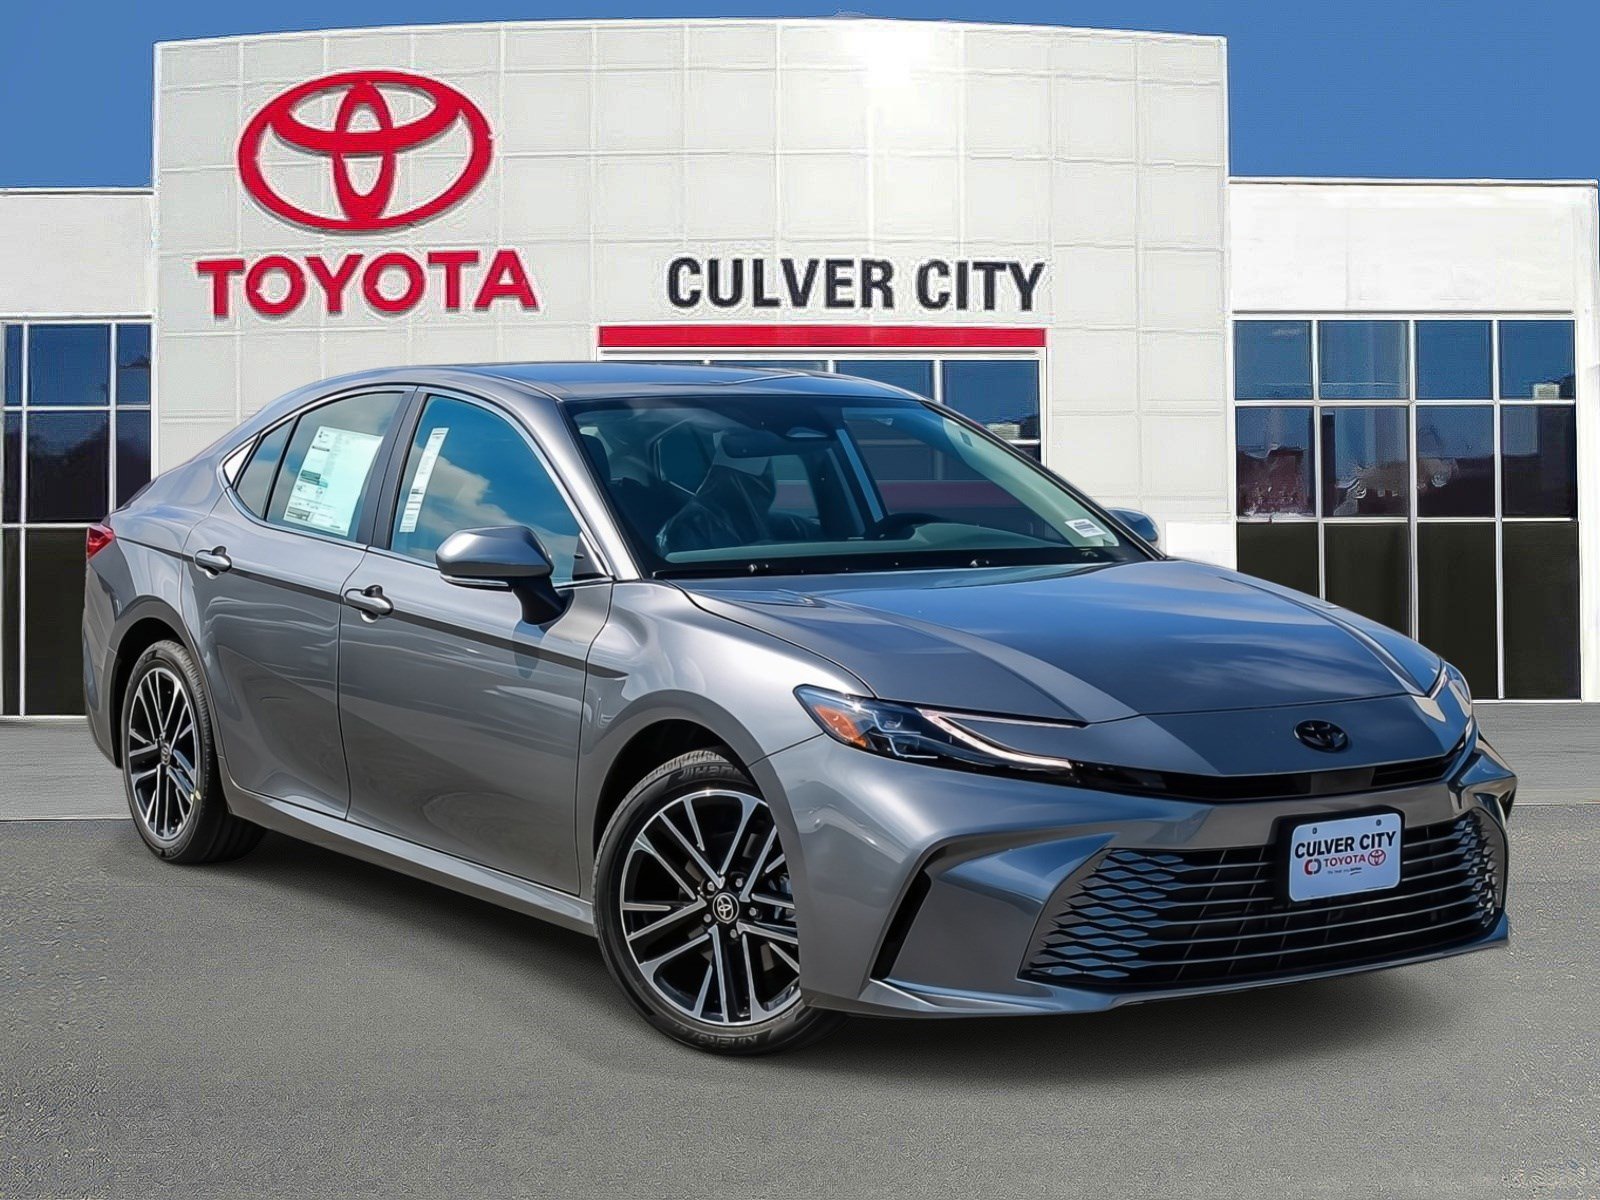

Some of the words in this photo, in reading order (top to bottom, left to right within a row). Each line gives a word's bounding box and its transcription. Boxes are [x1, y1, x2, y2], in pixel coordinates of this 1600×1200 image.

[196, 250, 539, 318] TOYOTA
[668, 257, 895, 309] CULVER
[916, 259, 1045, 311] CITY
[1295, 836, 1355, 859] CULVER
[1359, 830, 1397, 850] CITY
[1324, 854, 1366, 868] TOYOTA
